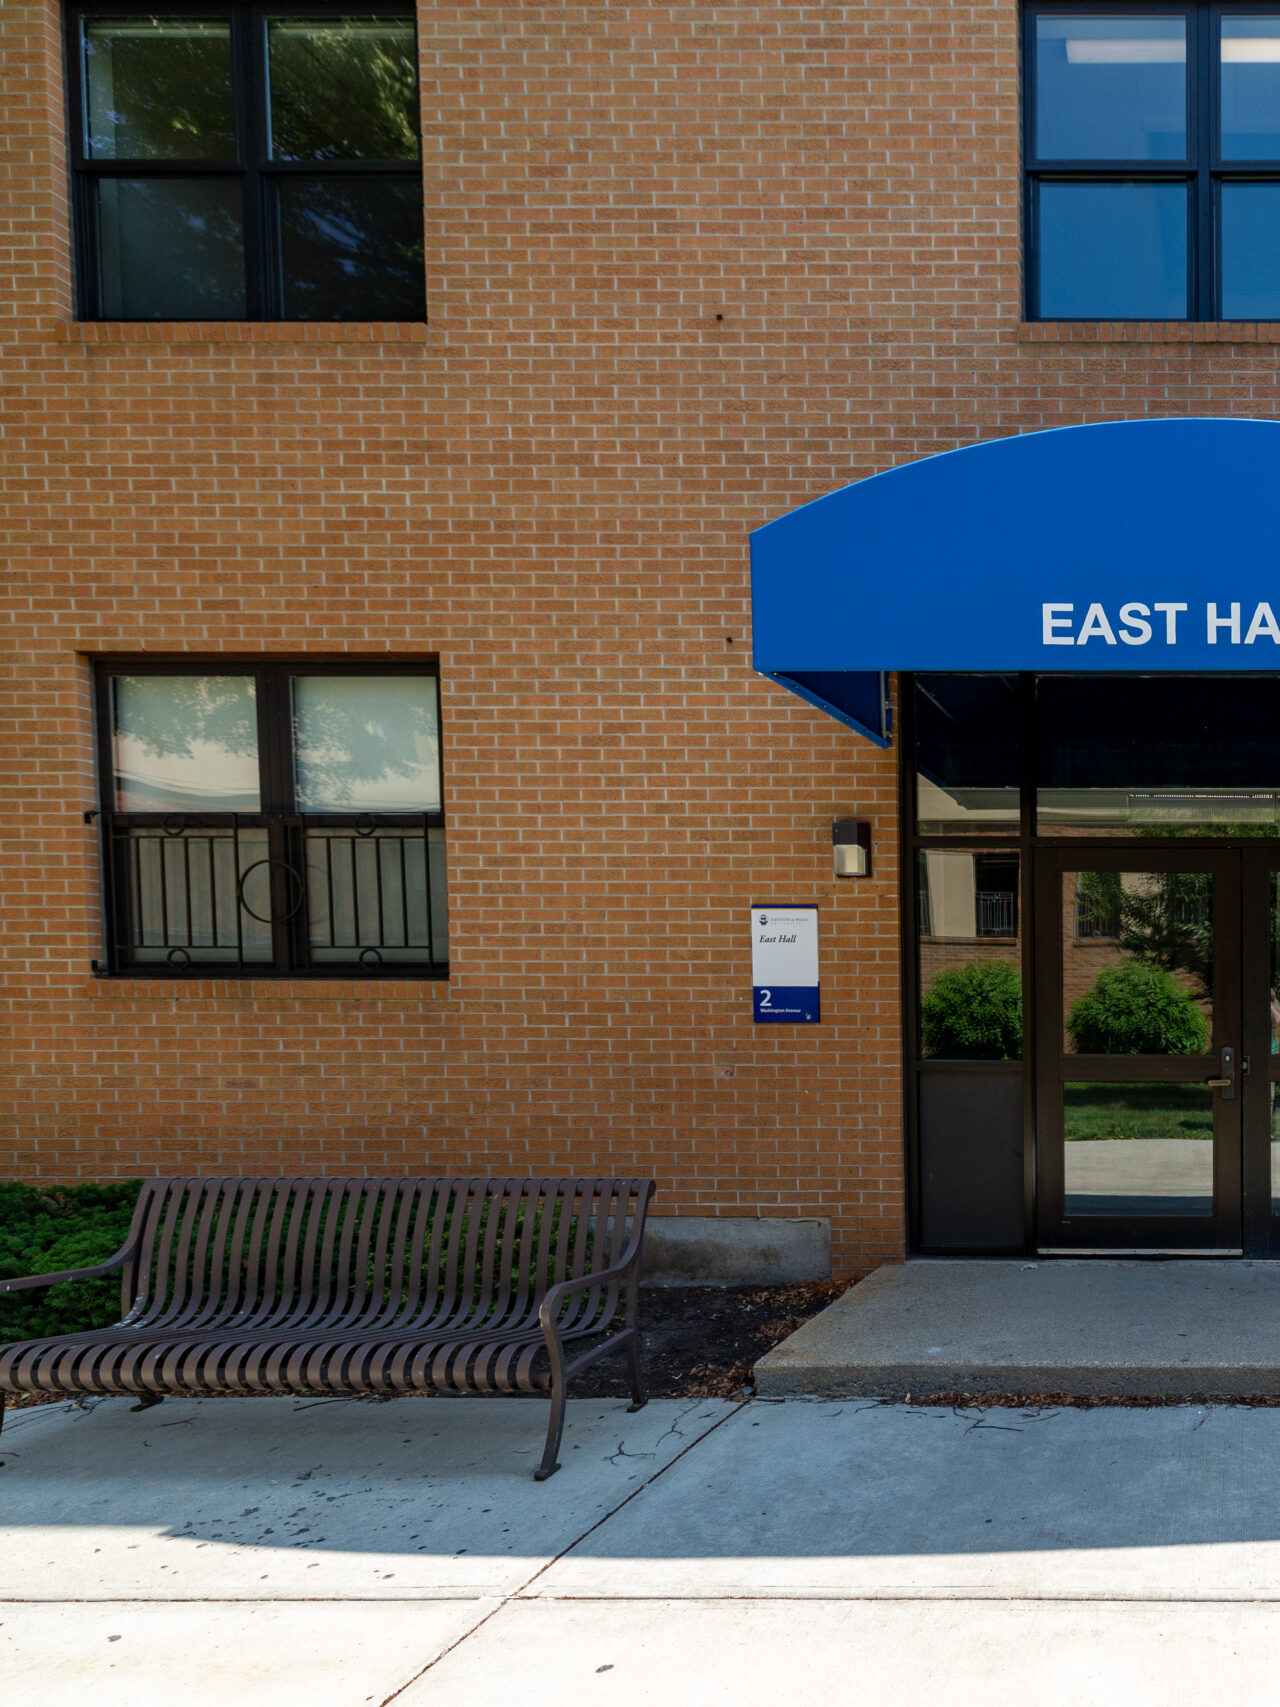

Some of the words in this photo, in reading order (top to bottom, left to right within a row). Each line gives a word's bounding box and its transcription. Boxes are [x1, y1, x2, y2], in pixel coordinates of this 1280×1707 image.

[1042, 602, 1188, 645] EAST
[760, 934, 776, 942] East
[779, 934, 796, 943] Hall
[760, 990, 772, 1006] 2
